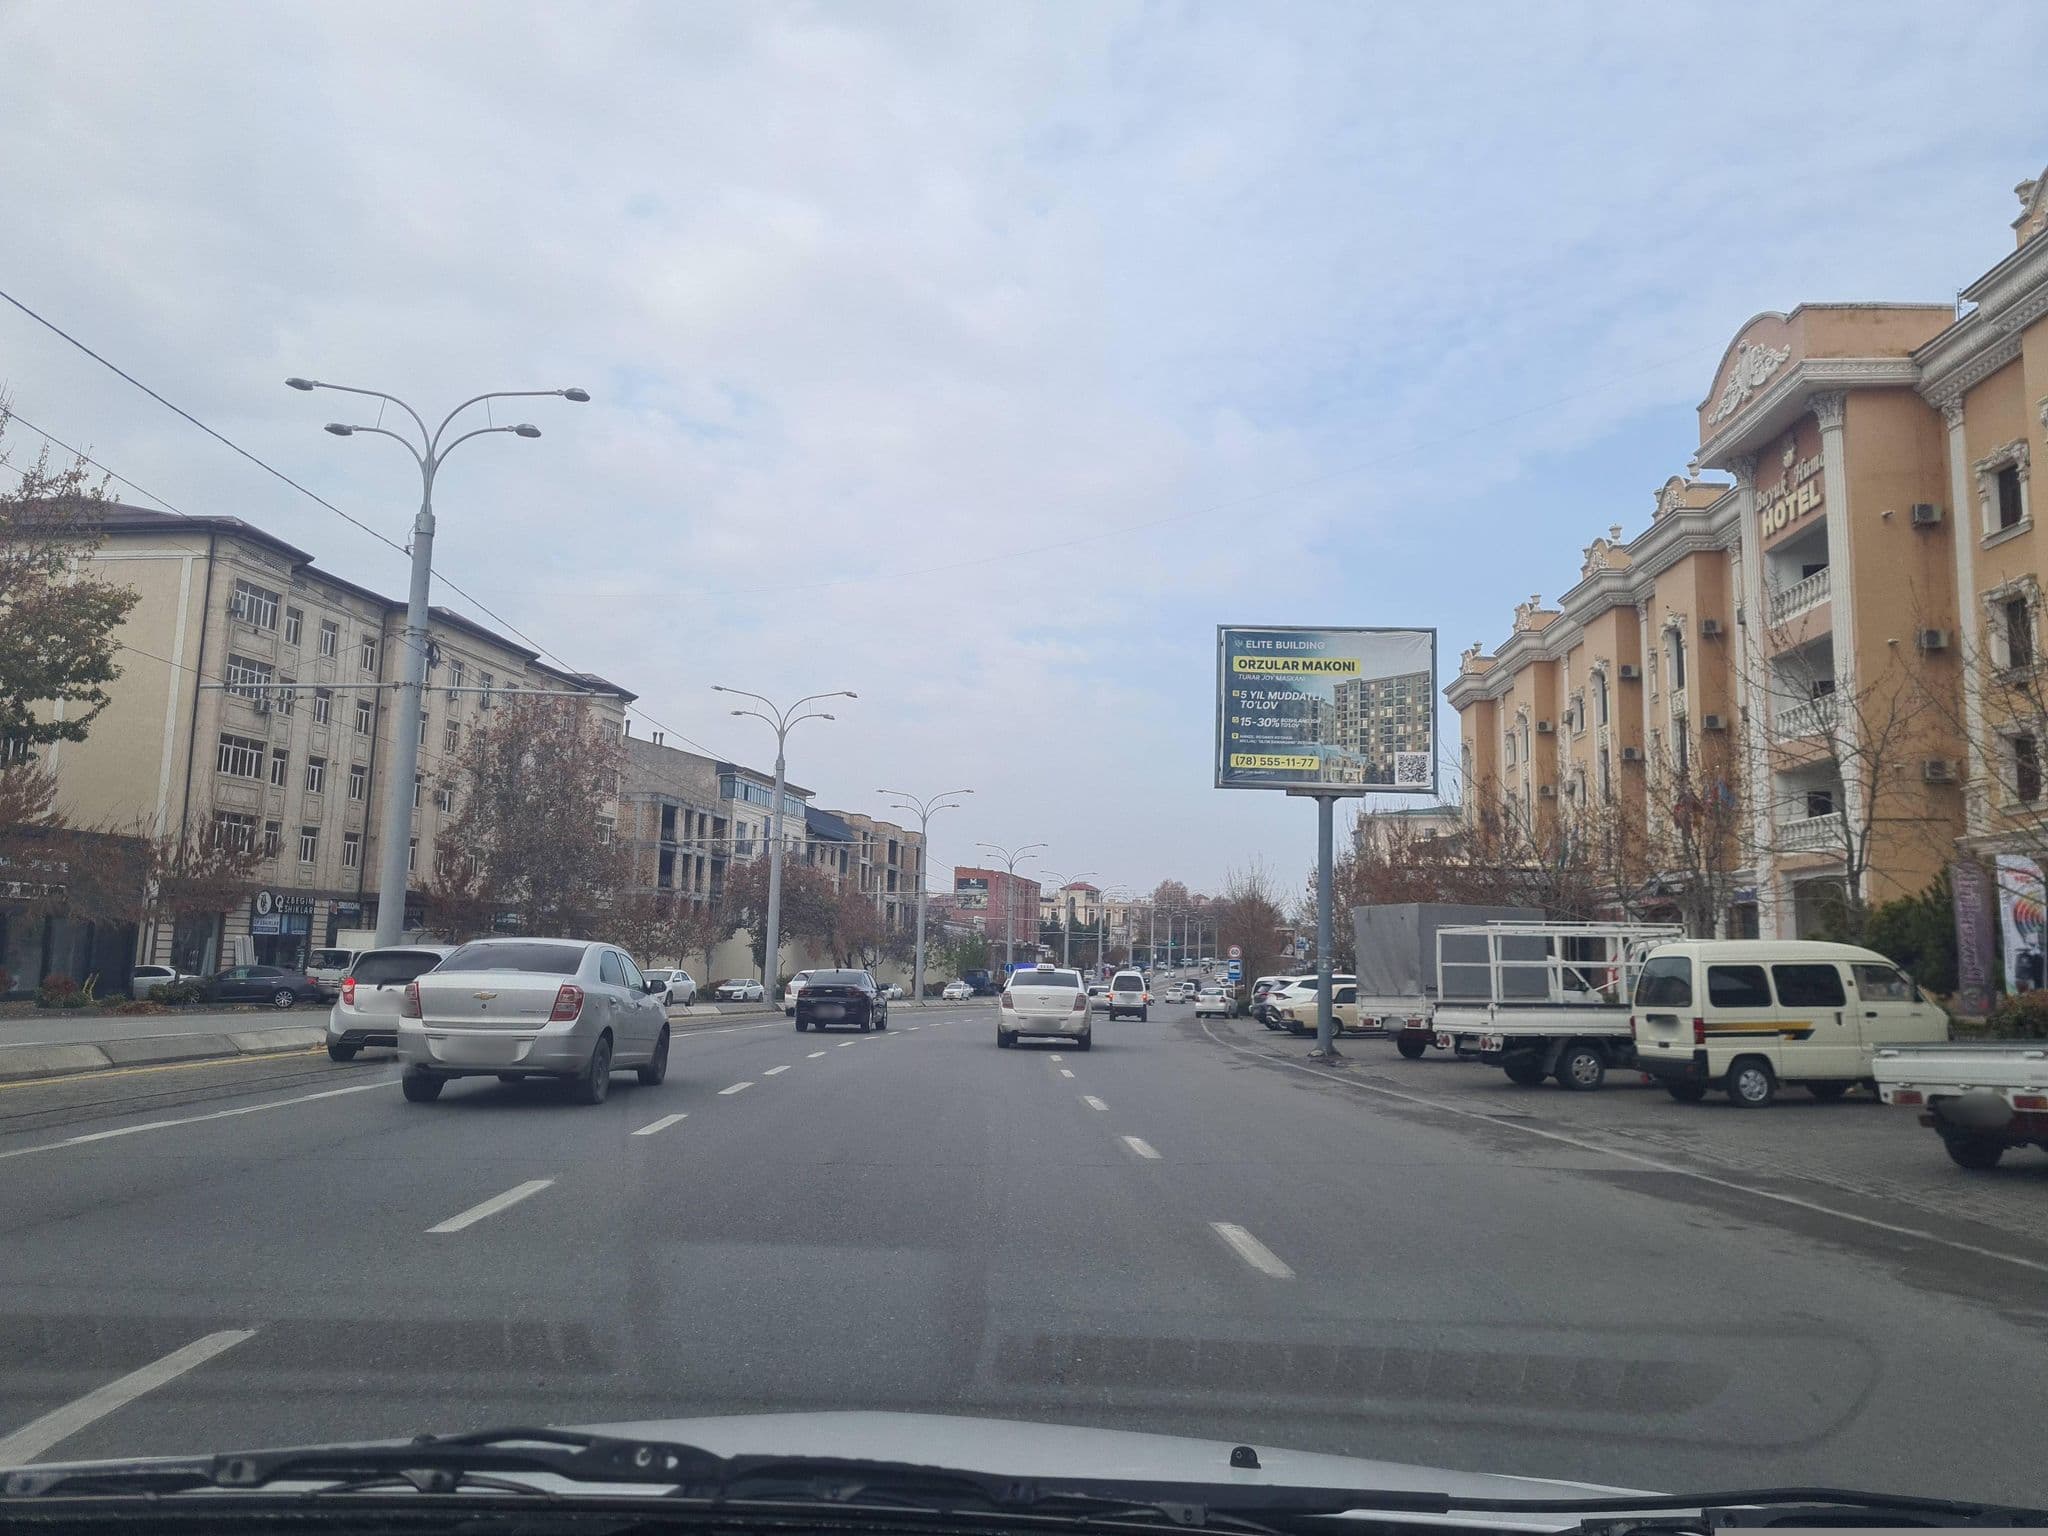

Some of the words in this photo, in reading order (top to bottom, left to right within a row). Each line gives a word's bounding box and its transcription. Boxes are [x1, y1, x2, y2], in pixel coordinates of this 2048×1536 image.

[1762, 479, 1822, 538] HOTEL
[1246, 640, 1272, 649] ELITE
[1276, 641, 1325, 650] BUILDING
[1238, 659, 1299, 671] ORZULAR
[1302, 660, 1355, 672] MAKONI
[1240, 690, 1247, 699] 5
[1250, 691, 1265, 700] YIL
[1267, 691, 1322, 701] MUDDATLI
[1240, 717, 1280, 728] 15-30%
[1235, 755, 1257, 766] (78)
[1260, 757, 1314, 767] 555-11-77
